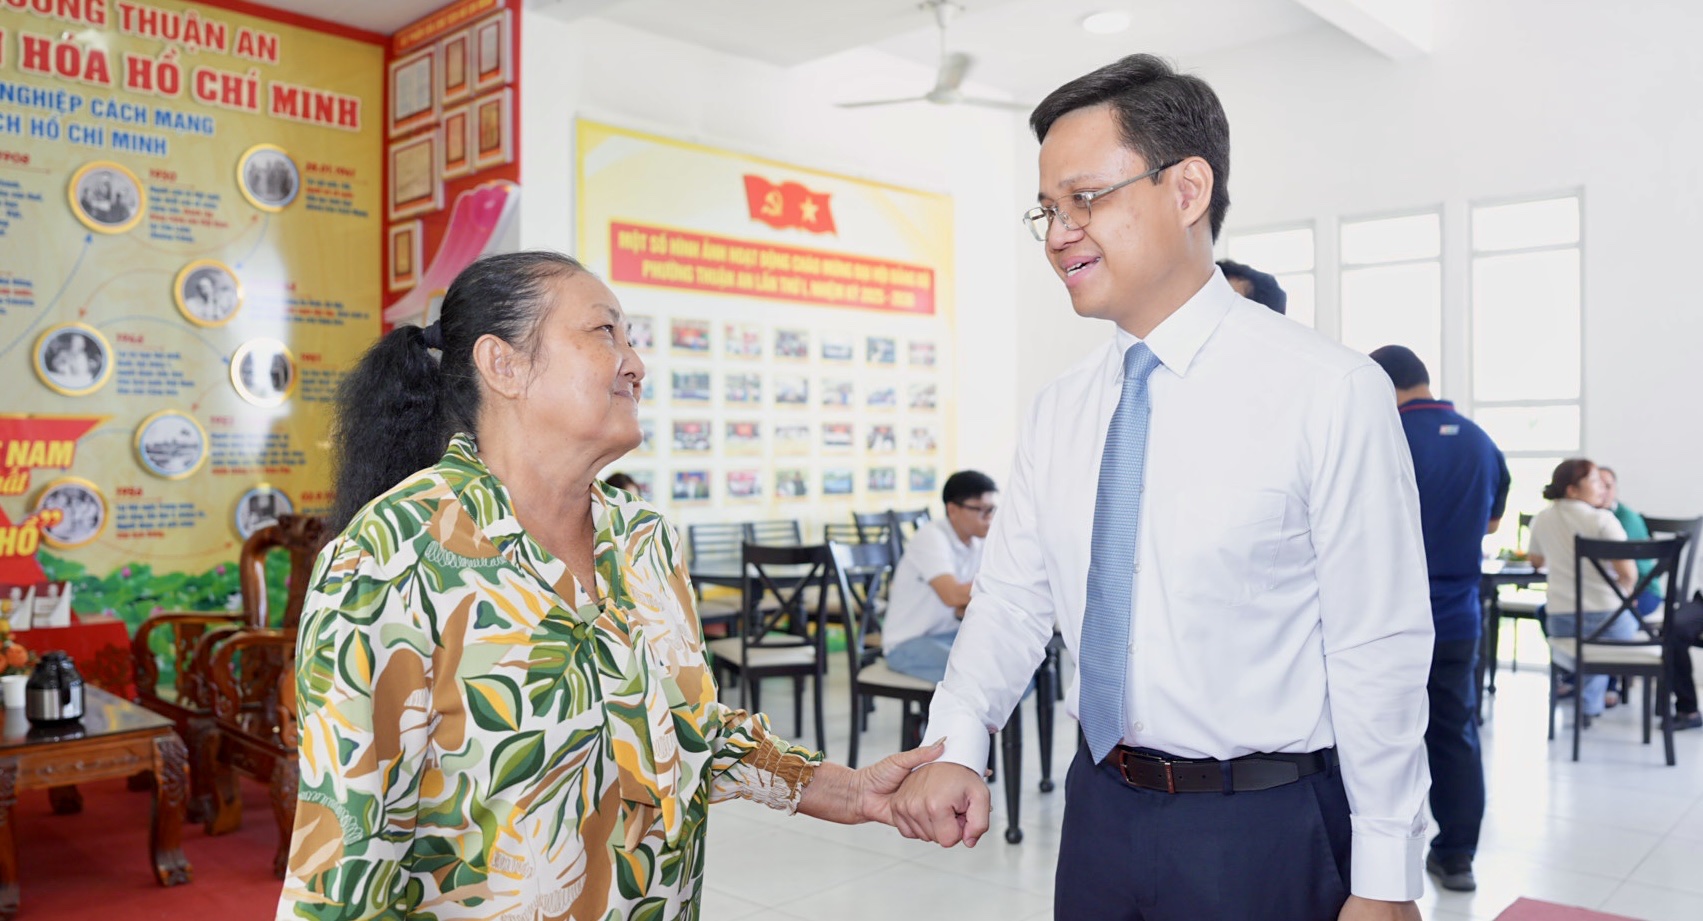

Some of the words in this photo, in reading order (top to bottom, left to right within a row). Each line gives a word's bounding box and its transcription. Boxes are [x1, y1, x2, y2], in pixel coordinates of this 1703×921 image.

[119, 3, 225, 52] THUẬN
[237, 31, 277, 62] AN
[23, 32, 110, 84] HÓA
[127, 49, 179, 95] HỒ
[196, 71, 258, 109] CHÍ
[272, 85, 358, 128] MINH
[91, 96, 147, 124] CÁCH
[155, 110, 214, 135] MẠNG
[112, 131, 167, 155] MINH
[5, 440, 75, 468] NAM
